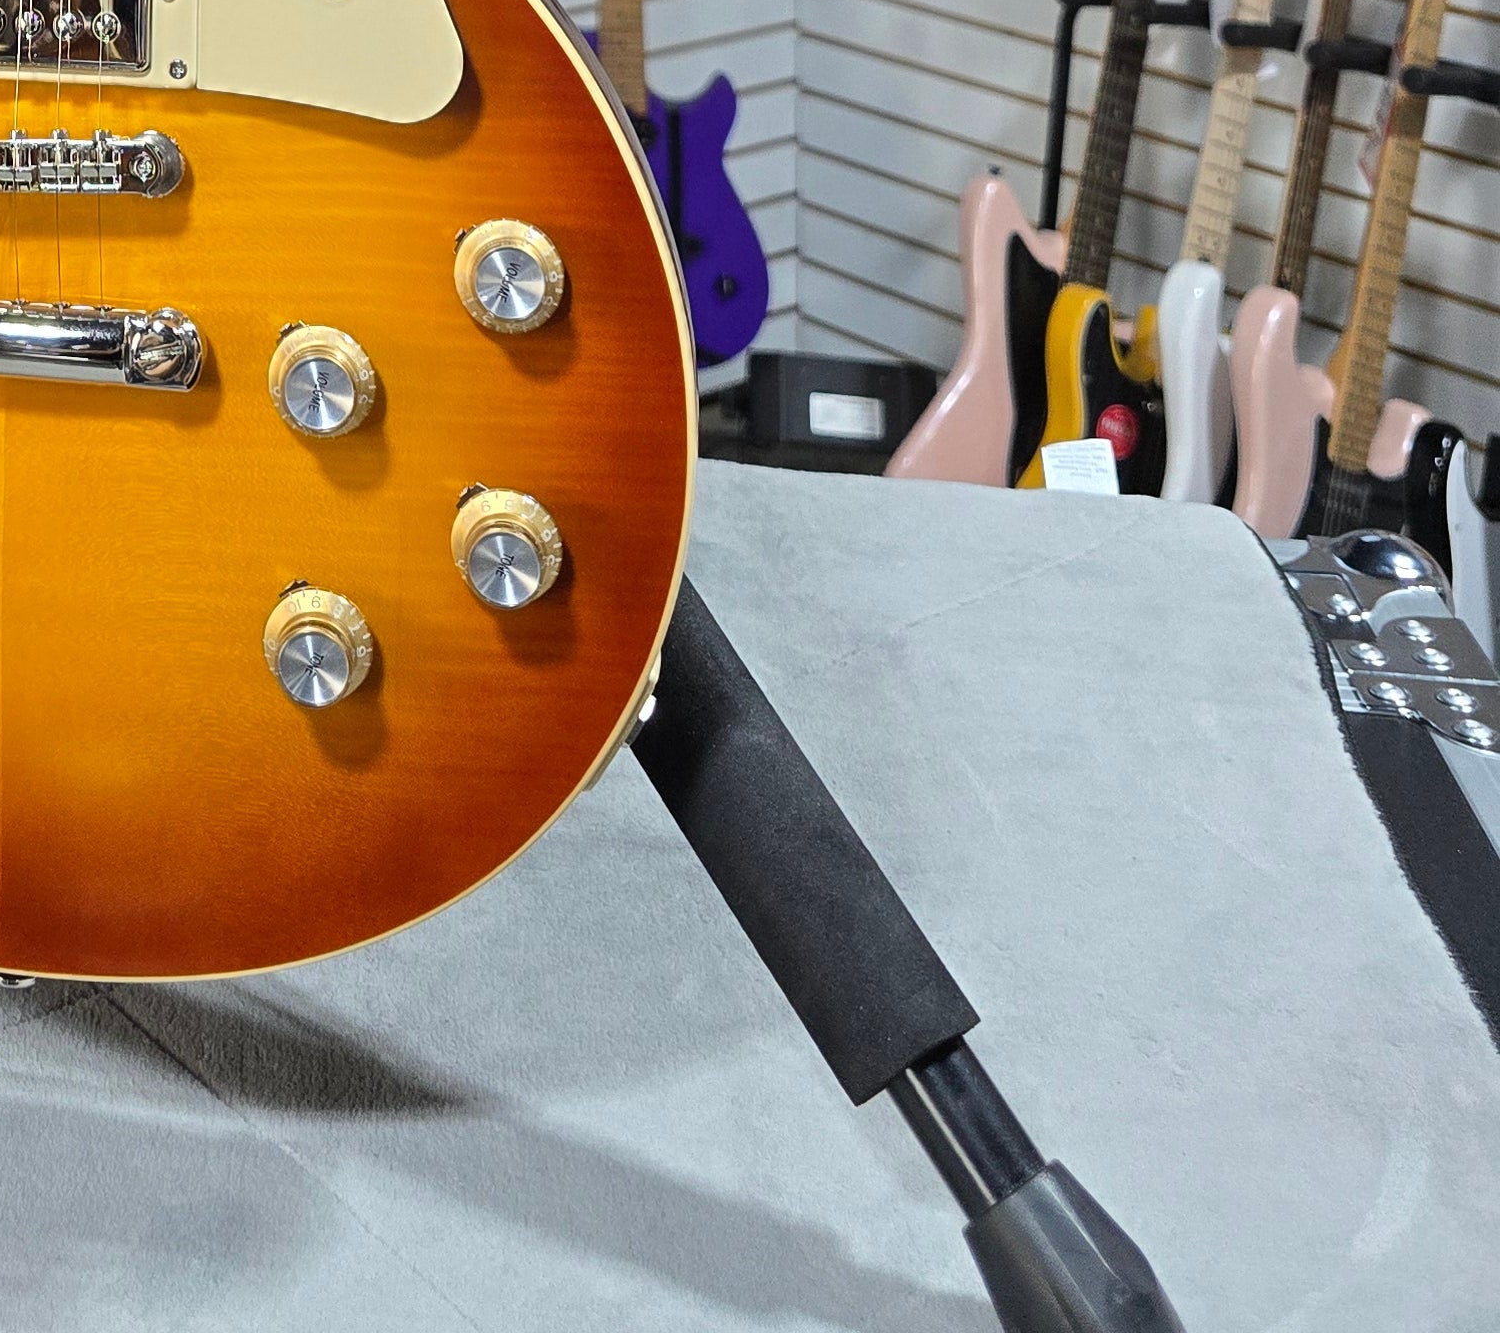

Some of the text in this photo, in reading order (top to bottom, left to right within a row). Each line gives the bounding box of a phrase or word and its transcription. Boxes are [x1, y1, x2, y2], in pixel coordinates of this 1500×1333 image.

[496, 262, 521, 303] VOLUME
[308, 371, 330, 414] VOLUME
[495, 552, 515, 580] TONE
